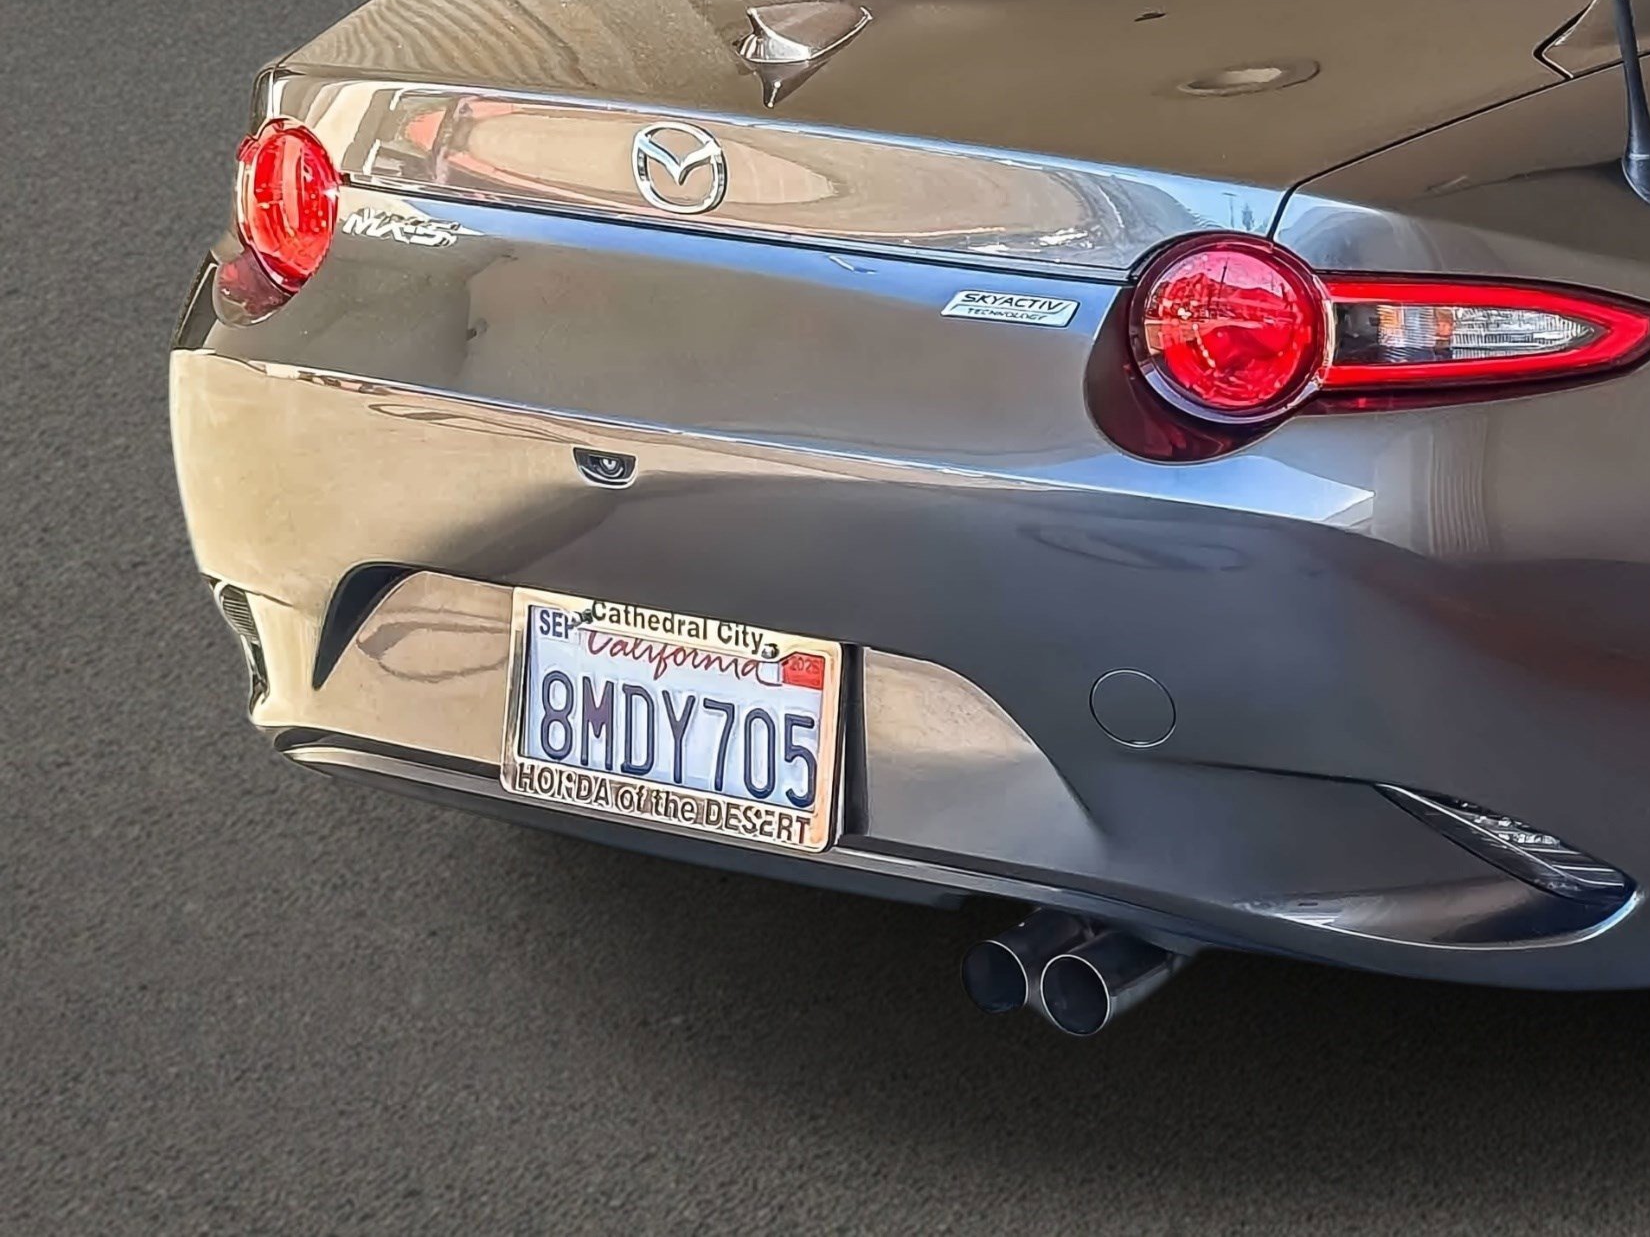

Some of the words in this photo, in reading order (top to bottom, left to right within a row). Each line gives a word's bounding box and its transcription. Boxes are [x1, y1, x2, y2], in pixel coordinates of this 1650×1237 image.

[961, 293, 1063, 311] SKYACTIV
[591, 600, 708, 641] Cathedral
[717, 621, 764, 656] City
[586, 629, 783, 688] California
[539, 670, 818, 810] 8MDY705
[515, 761, 610, 803] HONDA
[617, 785, 646, 813] of
[652, 790, 703, 824] the
[704, 798, 812, 846] DESERT
